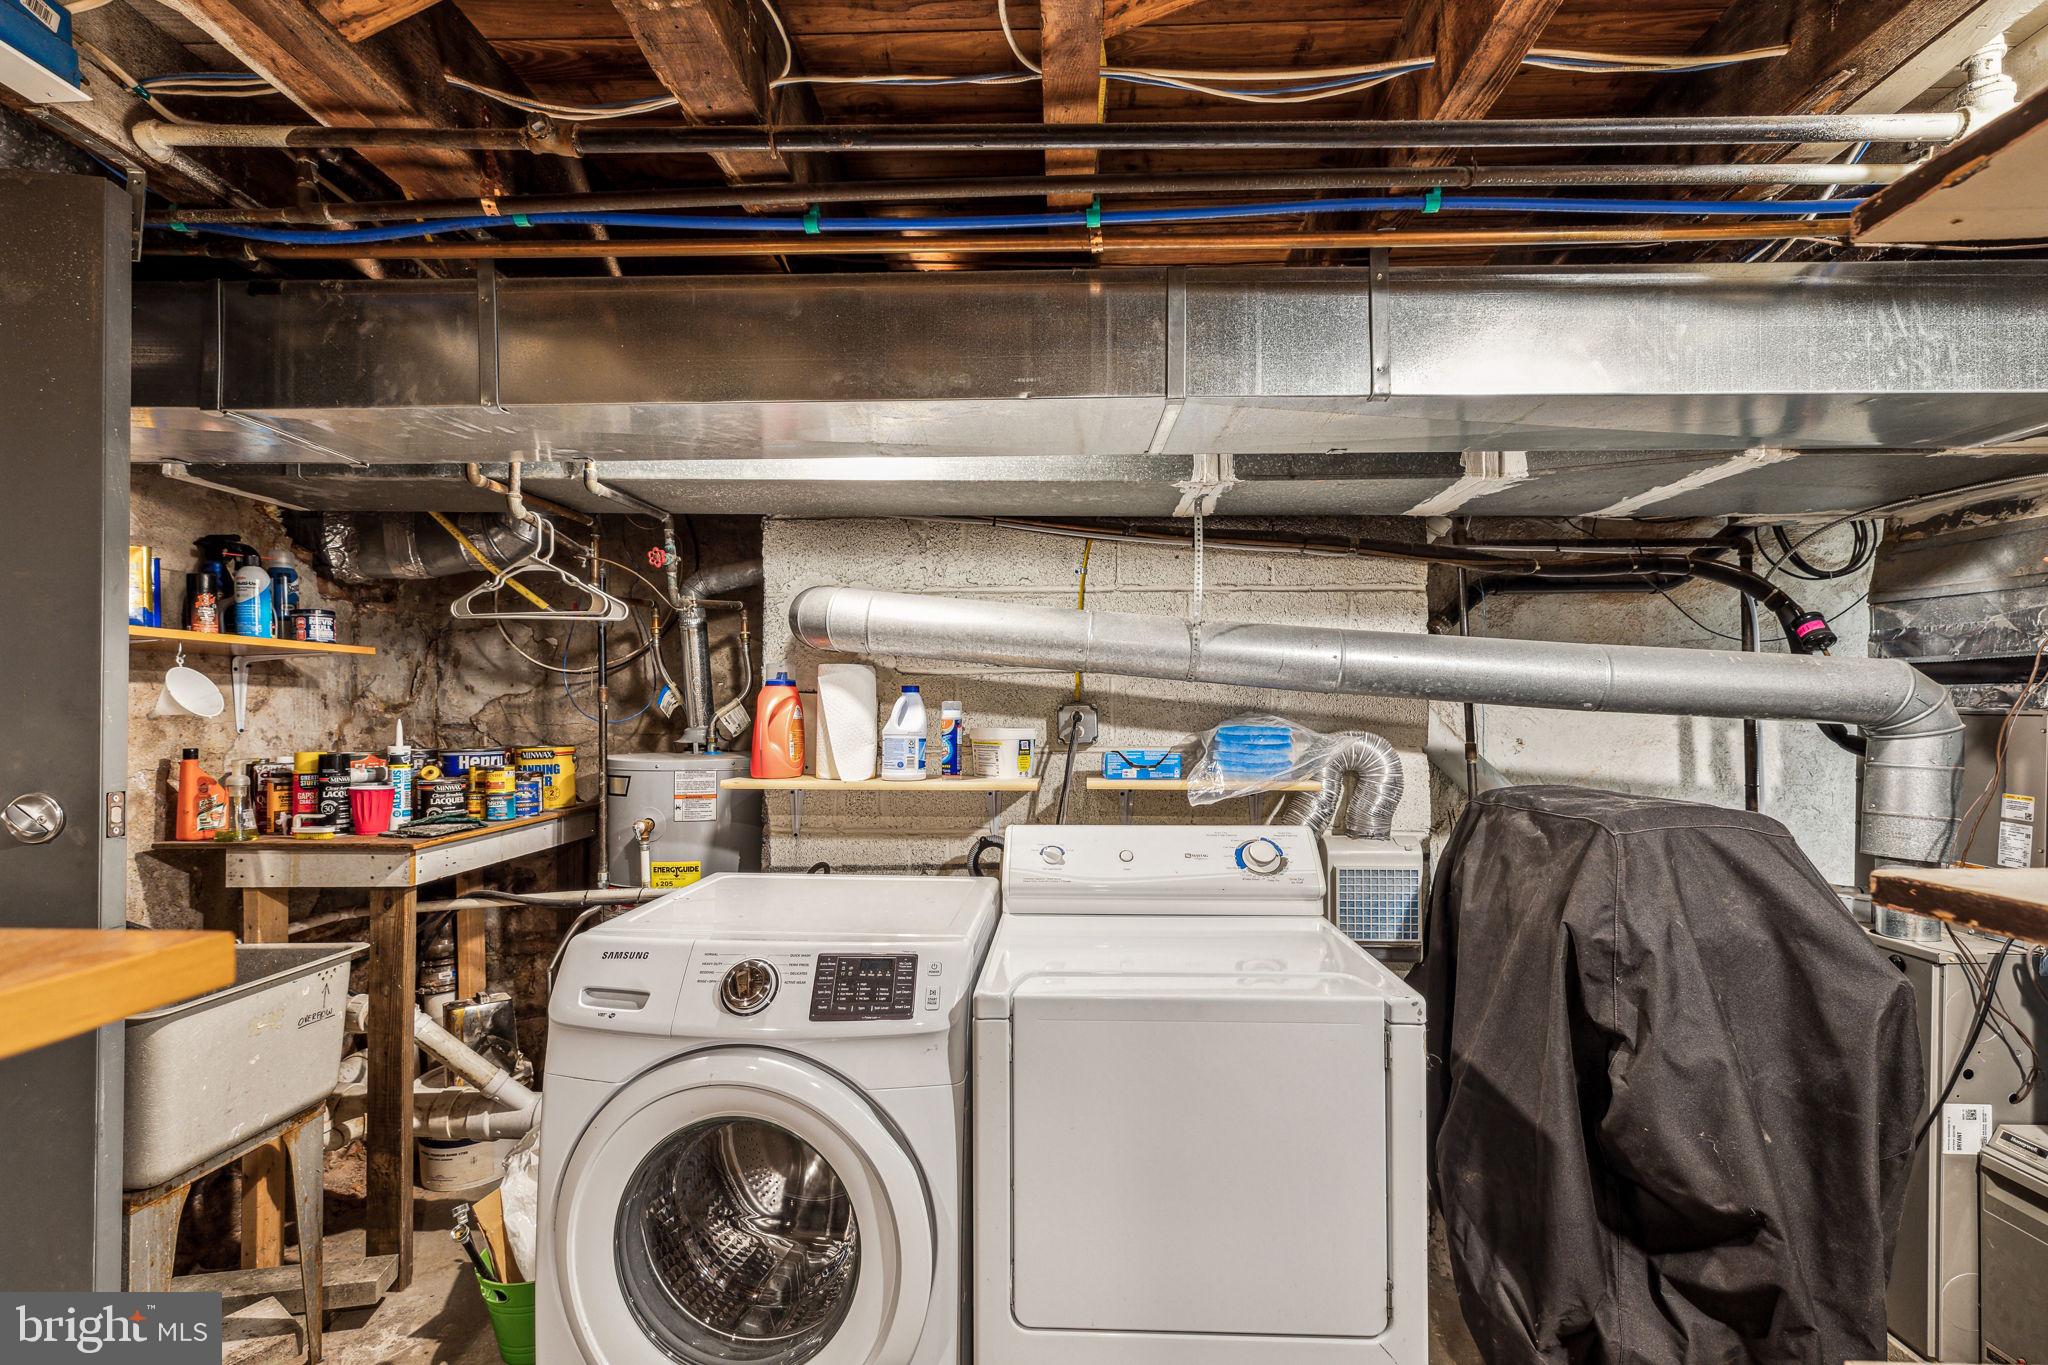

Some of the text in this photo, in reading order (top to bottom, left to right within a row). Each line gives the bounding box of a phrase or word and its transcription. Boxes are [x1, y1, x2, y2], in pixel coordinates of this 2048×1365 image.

[521, 751, 553, 759] MINWAX
[297, 792, 315, 800] GAPS
[430, 796, 465, 805] LACQUER
[653, 866, 700, 874] ENERGYGUIDE
[601, 951, 650, 960] SAMSUNG
[2010, 1136, 2039, 1153] Honeywell
